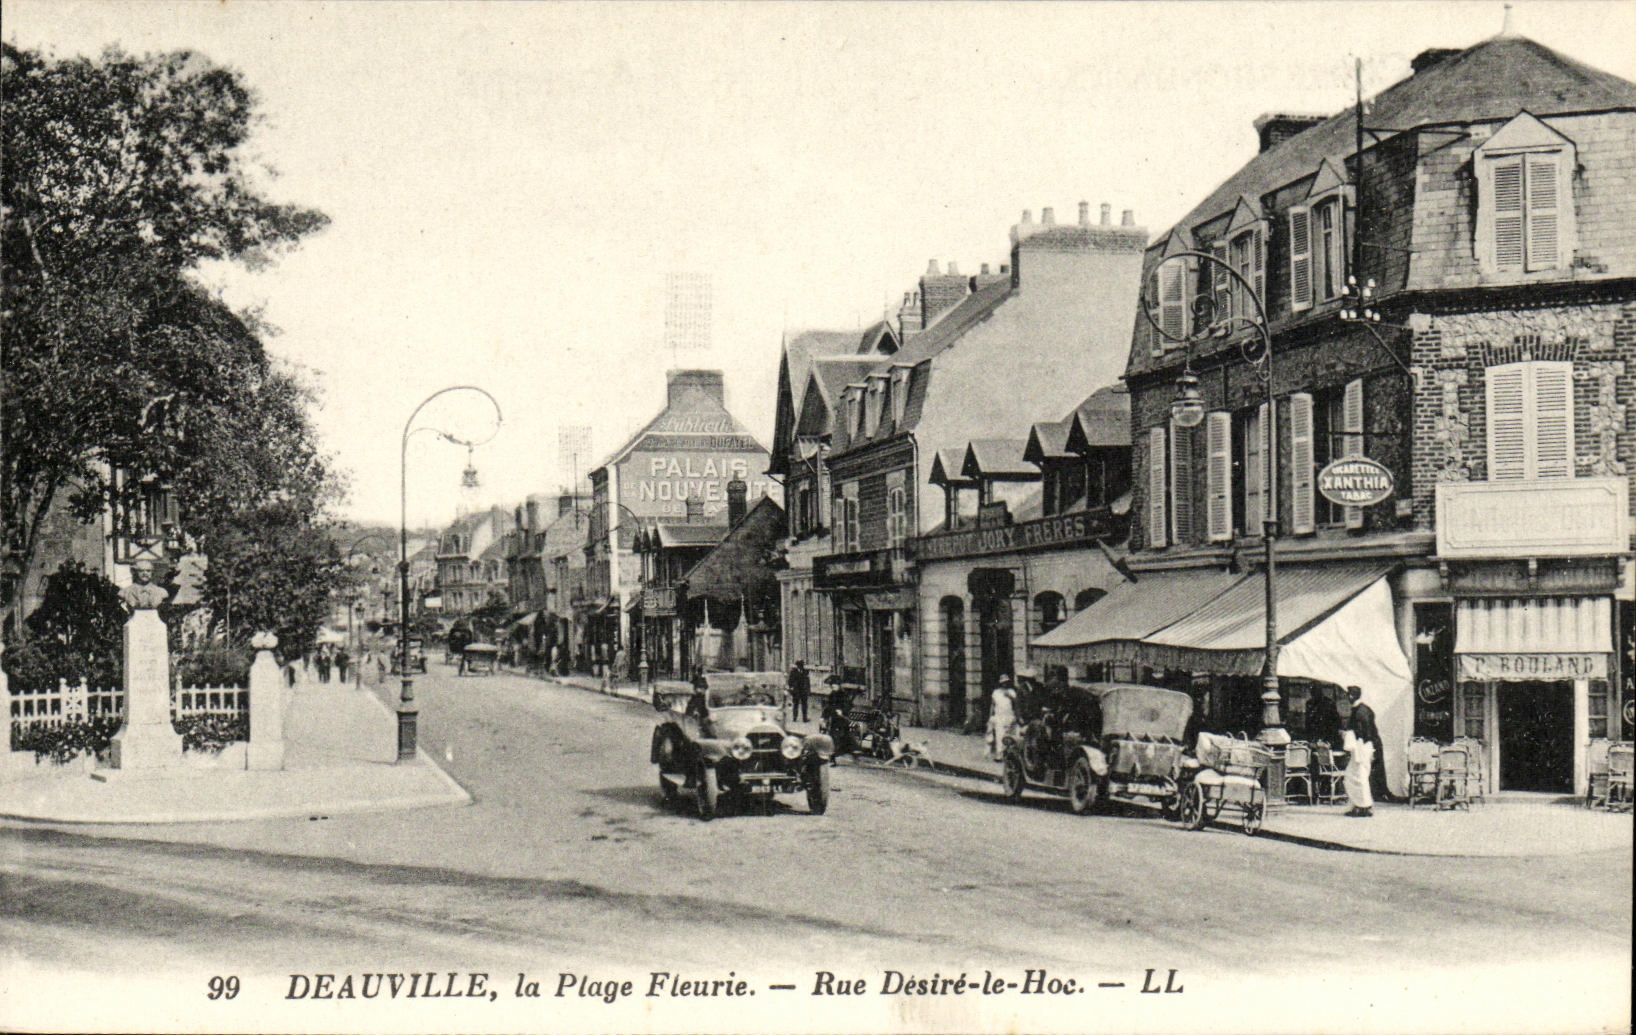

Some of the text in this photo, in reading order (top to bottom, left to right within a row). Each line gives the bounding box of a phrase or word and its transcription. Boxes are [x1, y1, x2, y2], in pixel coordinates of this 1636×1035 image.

[650, 457, 748, 478] PALAIS
[1323, 476, 1389, 489] XANTHIA
[1340, 491, 1373, 500] TABAC
